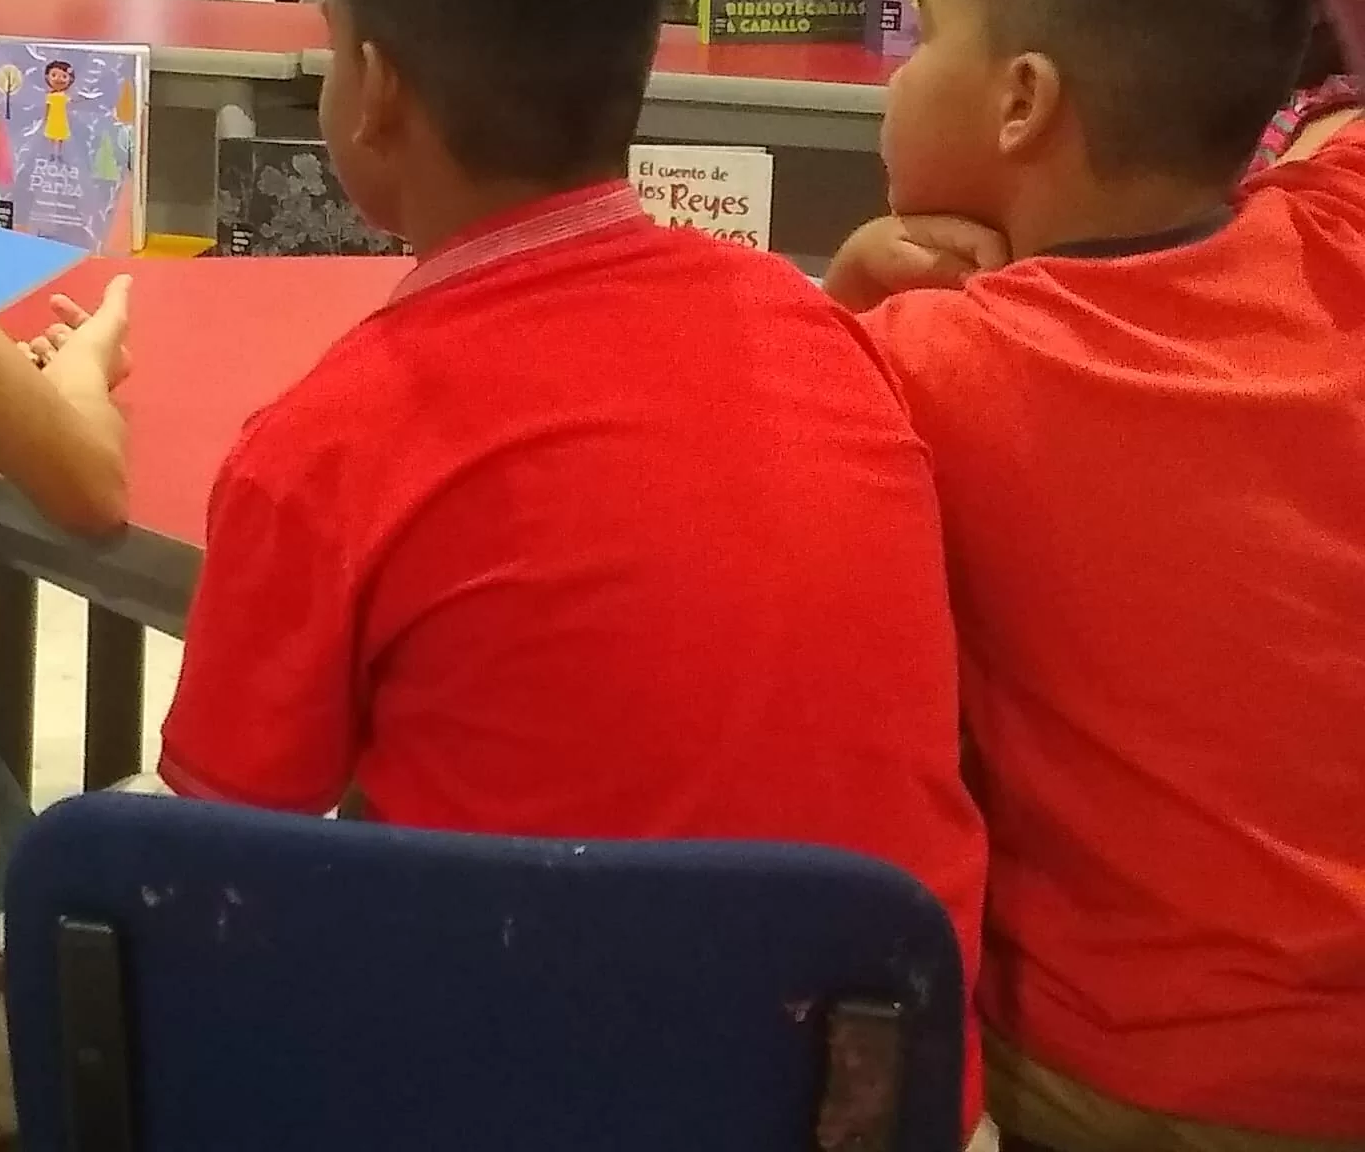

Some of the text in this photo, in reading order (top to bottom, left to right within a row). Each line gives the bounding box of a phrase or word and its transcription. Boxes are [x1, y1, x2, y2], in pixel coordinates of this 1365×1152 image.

[725, 0, 867, 16] BIBLIOTECARIAS
[740, 18, 811, 33] CABALLO
[33, 158, 80, 182] Rosa
[639, 161, 729, 182] El cuento de
[29, 174, 84, 198] Parks
[638, 180, 750, 220] los Reyes
